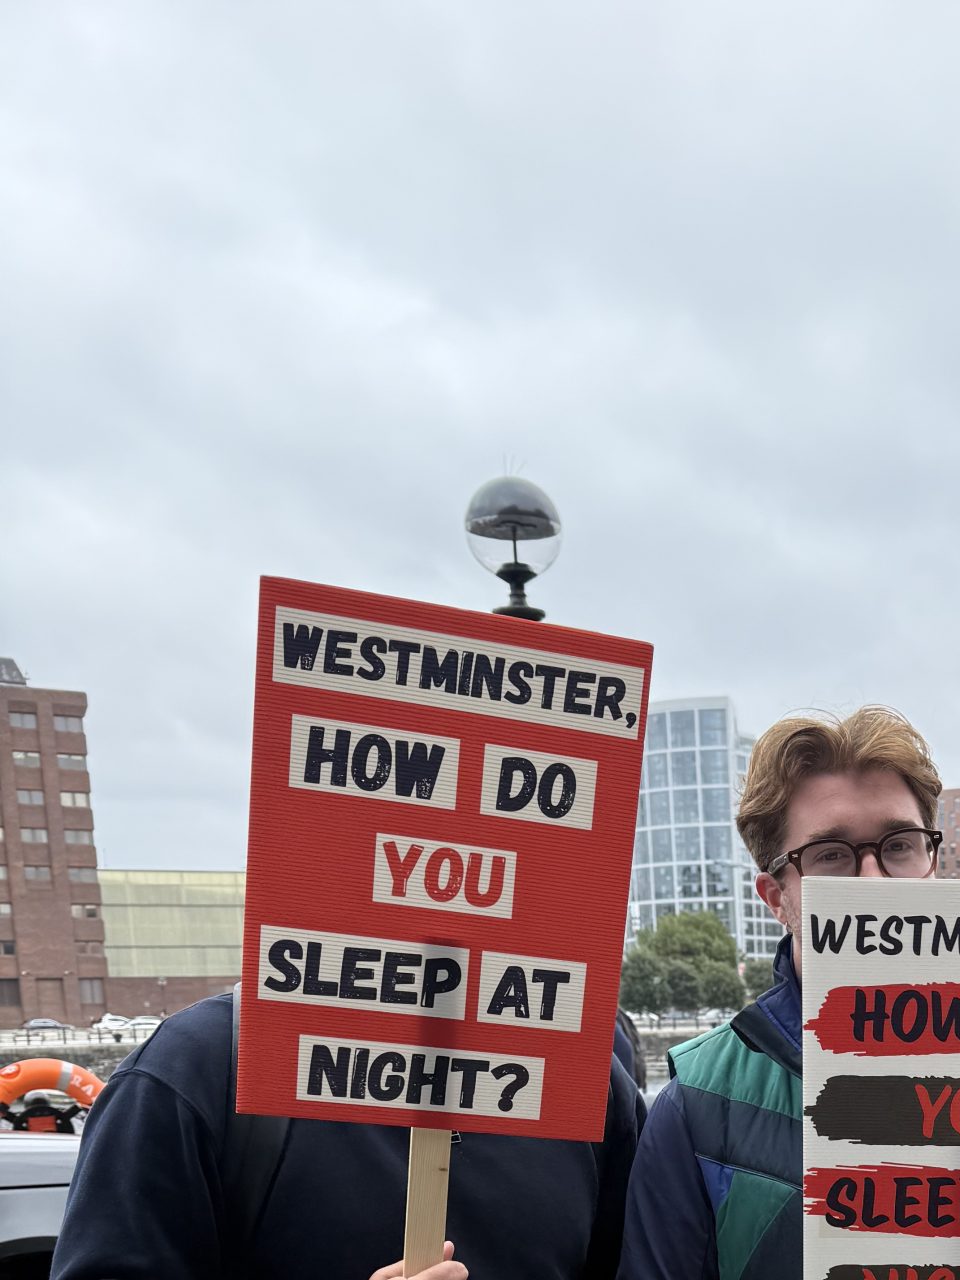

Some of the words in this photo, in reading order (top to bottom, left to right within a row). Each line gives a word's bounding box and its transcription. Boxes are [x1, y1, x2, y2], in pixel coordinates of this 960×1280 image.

[282, 622, 637, 729] WESTMINSTER,
[303, 725, 446, 801] HOW
[495, 756, 577, 819] DO
[383, 841, 505, 908] YOU
[263, 939, 462, 1009] SLEEP
[486, 965, 571, 1021] AT
[306, 1044, 530, 1112] NIGHT?
